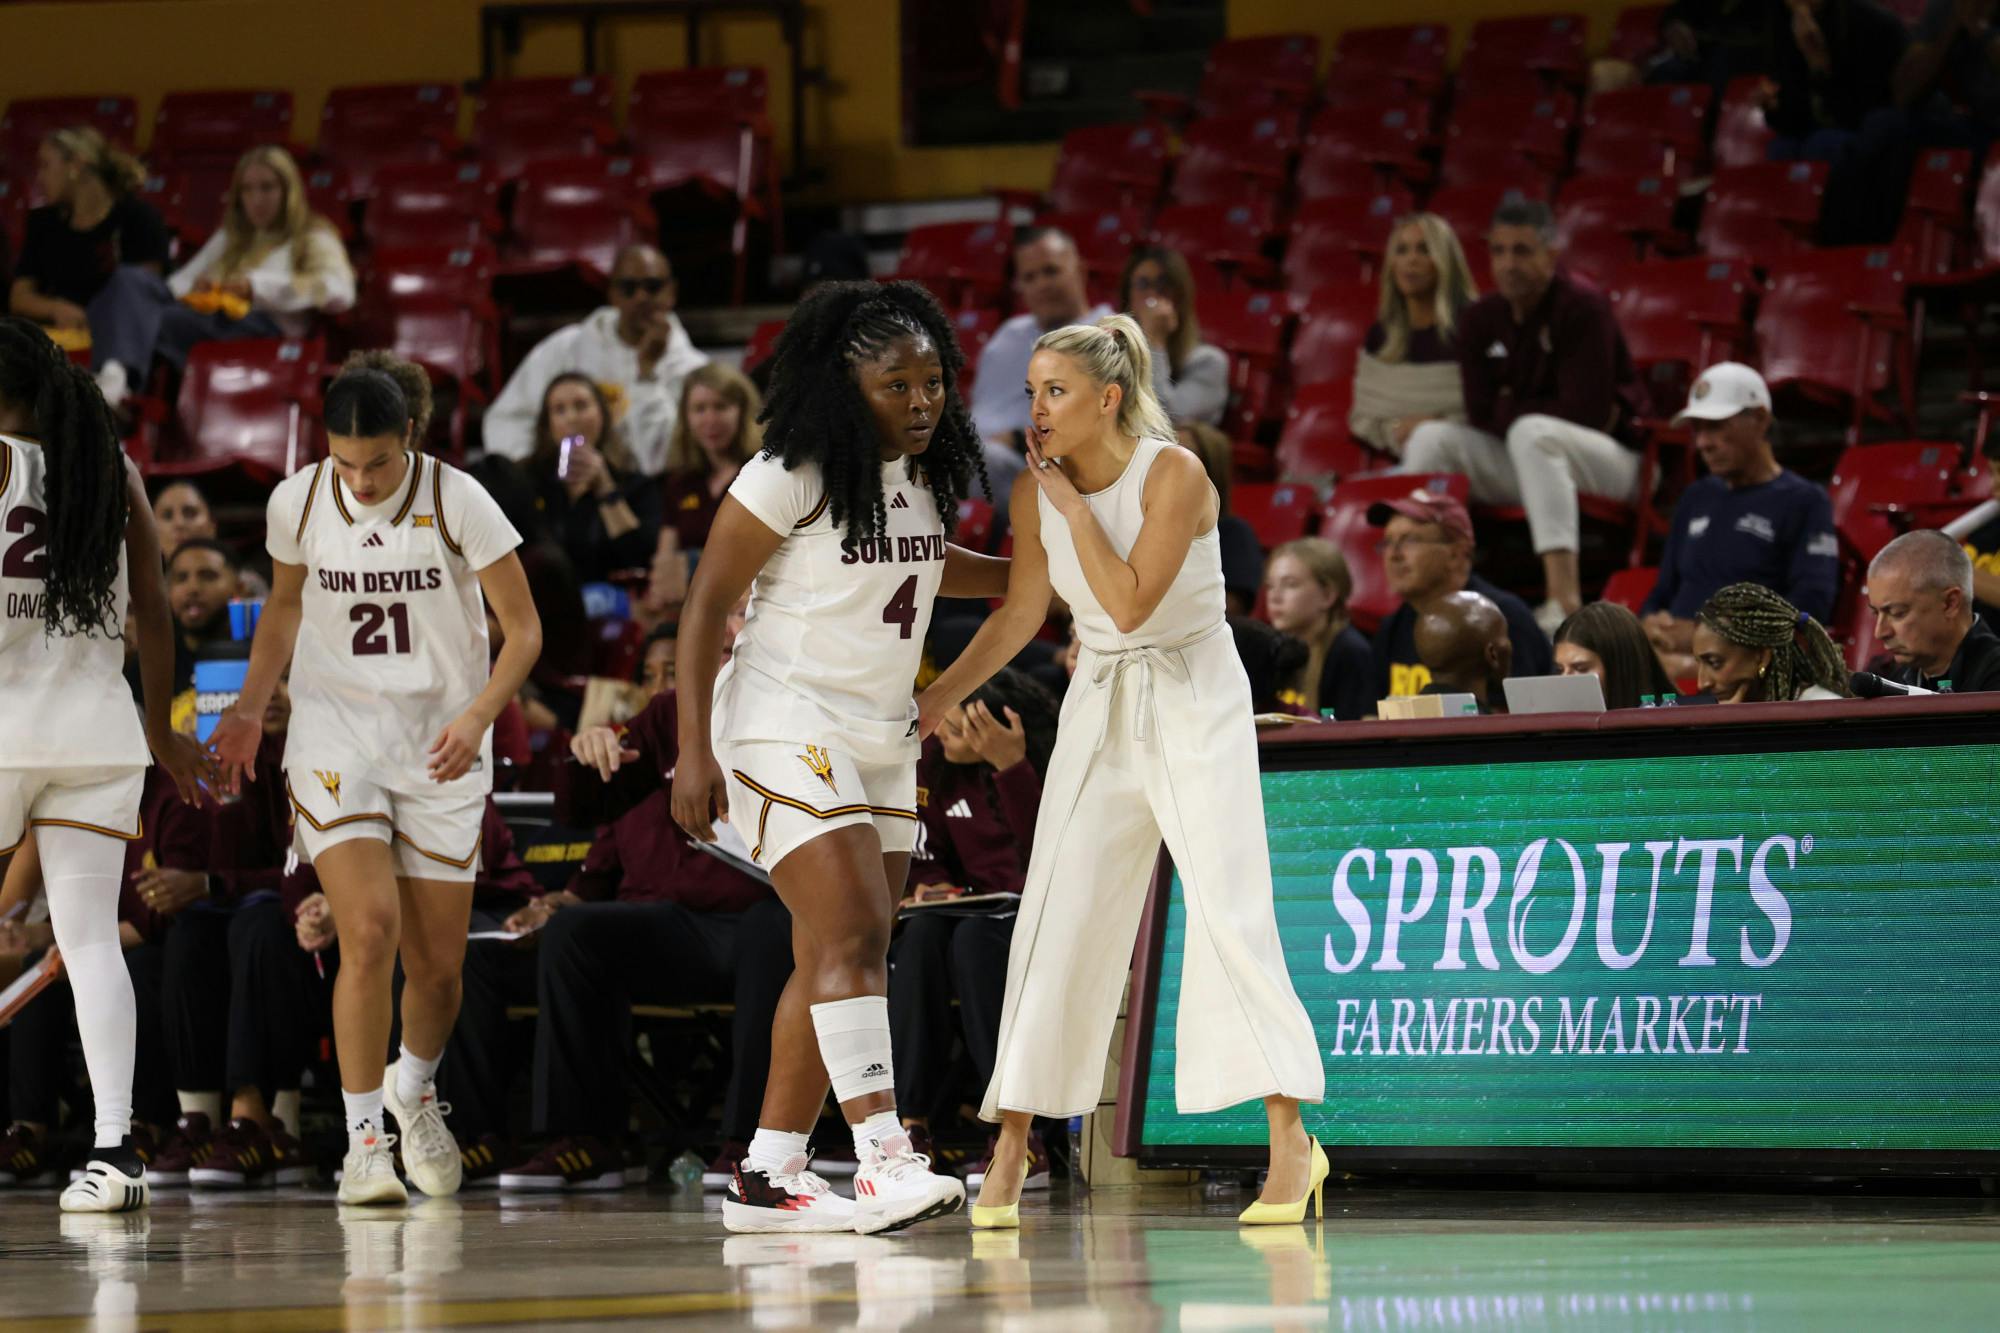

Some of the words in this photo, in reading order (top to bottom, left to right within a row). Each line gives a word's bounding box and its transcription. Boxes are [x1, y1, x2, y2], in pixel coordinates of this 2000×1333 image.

[2, 505, 48, 579] 2
[897, 534, 945, 563] DEVIL
[318, 568, 357, 593] SUN
[362, 567, 441, 594] DEVILS
[882, 574, 918, 640] 4
[350, 602, 411, 656] 21
[1331, 996, 1543, 1056] FARMERS
[1550, 993, 1763, 1055] MARKET
